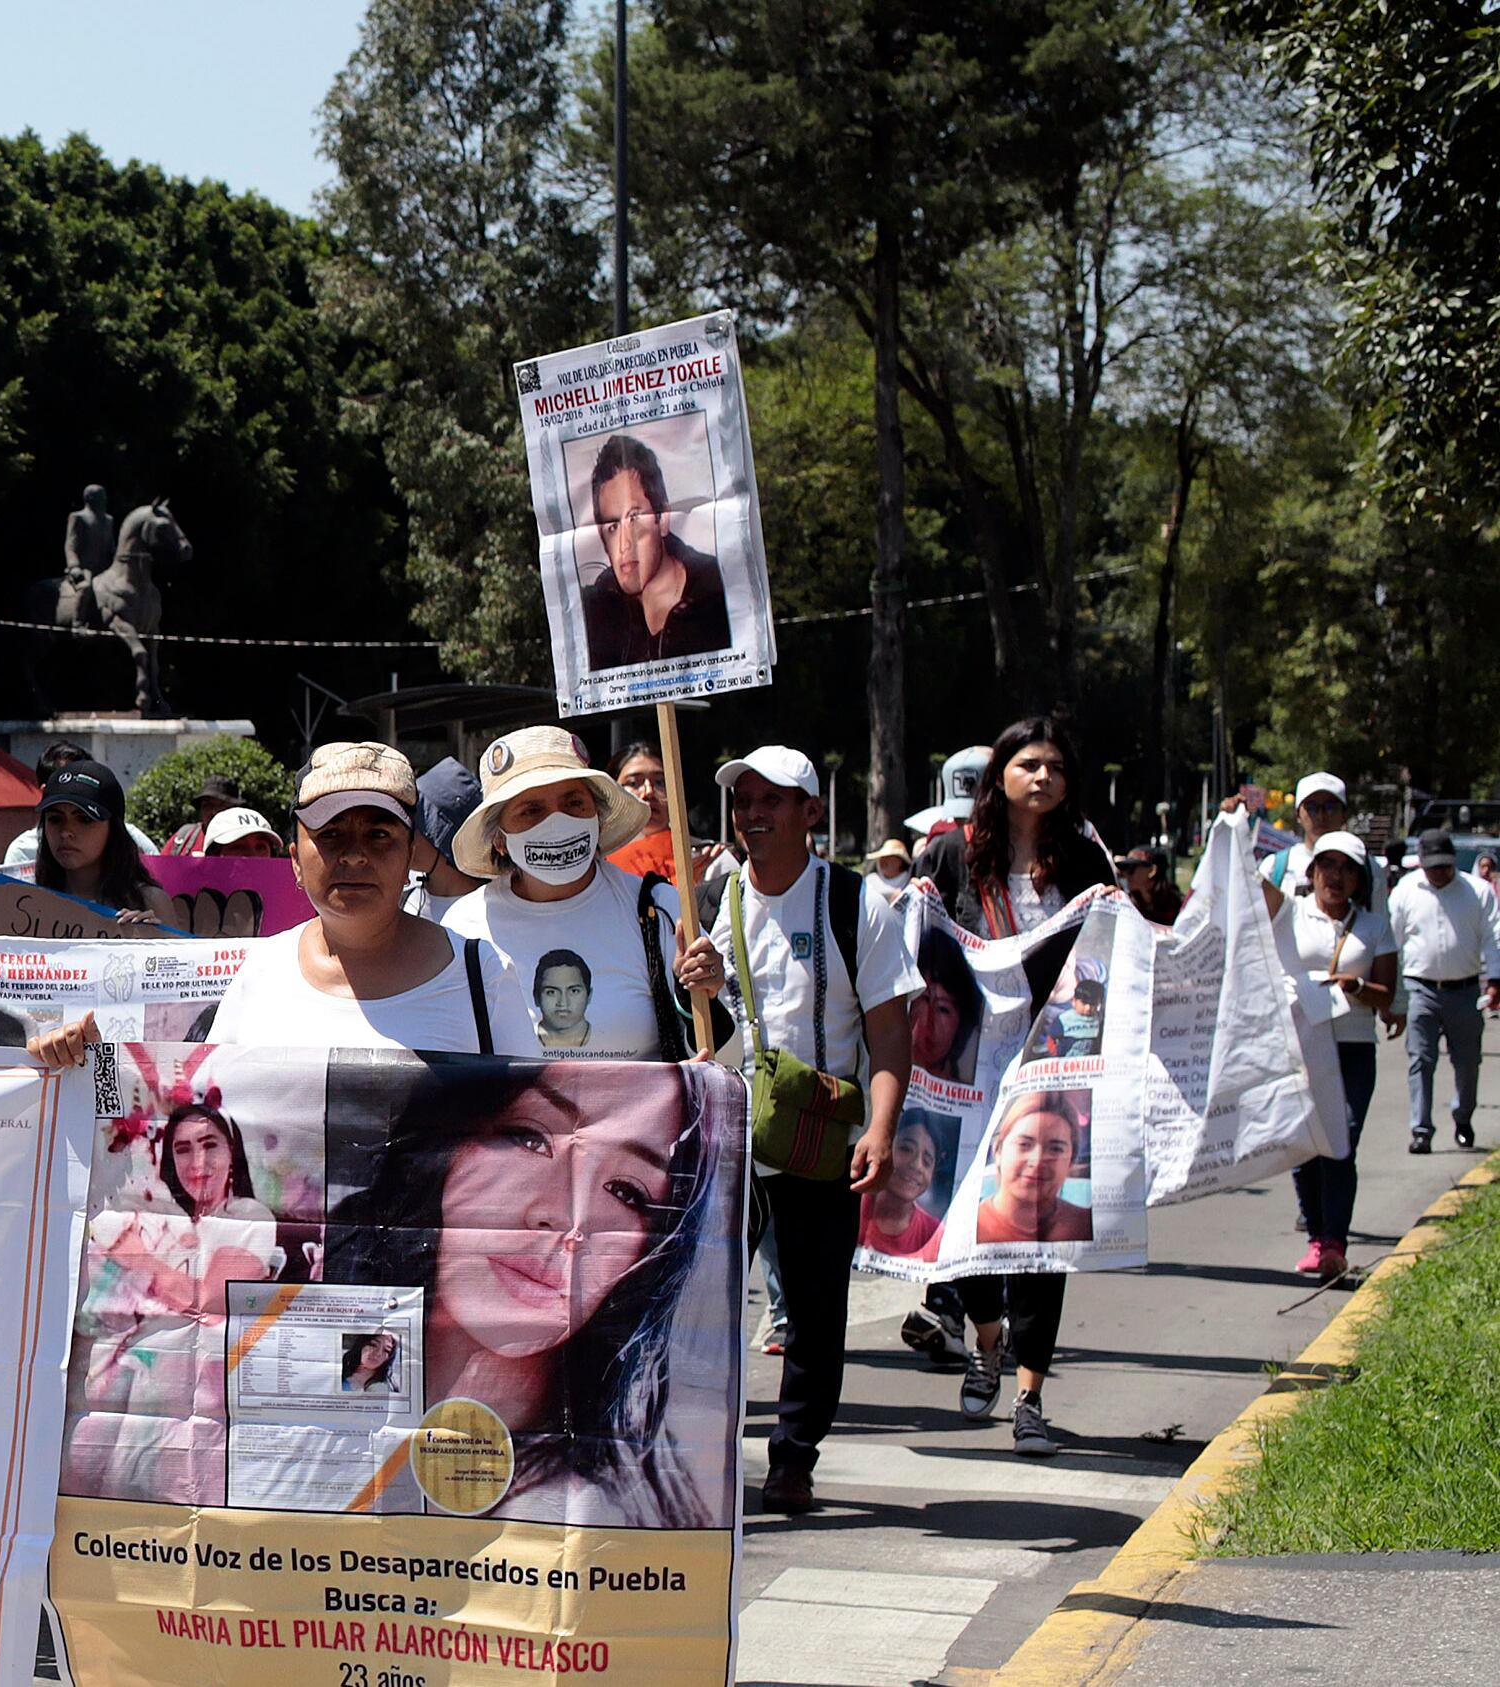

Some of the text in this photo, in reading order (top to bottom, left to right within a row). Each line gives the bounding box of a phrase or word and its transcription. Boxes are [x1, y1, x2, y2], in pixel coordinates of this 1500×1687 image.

[534, 356, 722, 416] MICHELL JIMÉNEZ TOXTLE
[557, 373, 572, 387] VOZ
[573, 369, 583, 382] DE
[584, 365, 599, 380] LOS
[658, 348, 668, 362] EN
[670, 342, 699, 361] PUEBLA
[540, 411, 584, 428] 18/02/2016
[633, 393, 651, 404] San
[690, 376, 725, 392] Cholula
[577, 423, 598, 434] edad
[600, 417, 608, 428] al
[660, 404, 670, 414] 21
[214, 947, 247, 962] JOSÉ
[74, 1532, 686, 1592] Colectivo Voz de los Desaparecidos en Puebla
[324, 1586, 438, 1616] Busca a:
[156, 1609, 610, 1673] MARIA DEL PILAR ALARCÓN VELASCO
[339, 1662, 426, 1687] 23 años
